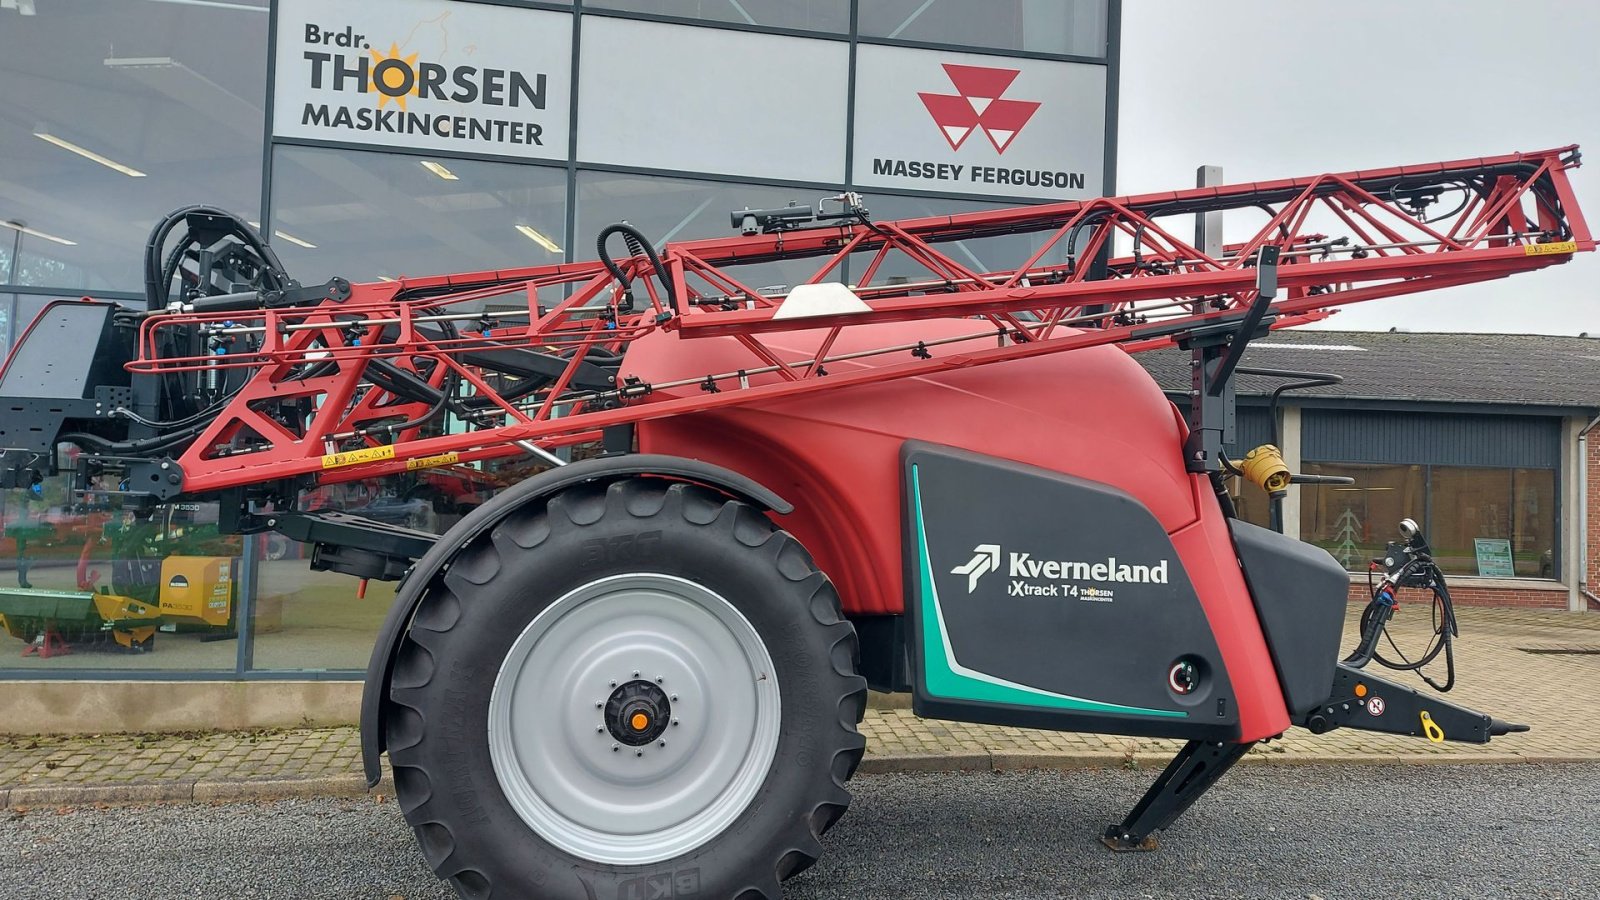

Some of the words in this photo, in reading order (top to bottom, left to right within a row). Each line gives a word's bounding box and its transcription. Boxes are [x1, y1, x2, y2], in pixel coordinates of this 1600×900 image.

[304, 23, 370, 49] Brdr.
[303, 51, 547, 110] THORSEN
[301, 103, 544, 146] MASKINCENTER
[873, 158, 964, 181] MASSEY
[971, 166, 1085, 189] FERGUSON
[1009, 552, 1168, 584] Kverneland
[1062, 585, 1078, 597] T4
[1080, 587, 1114, 597] THORSEN
